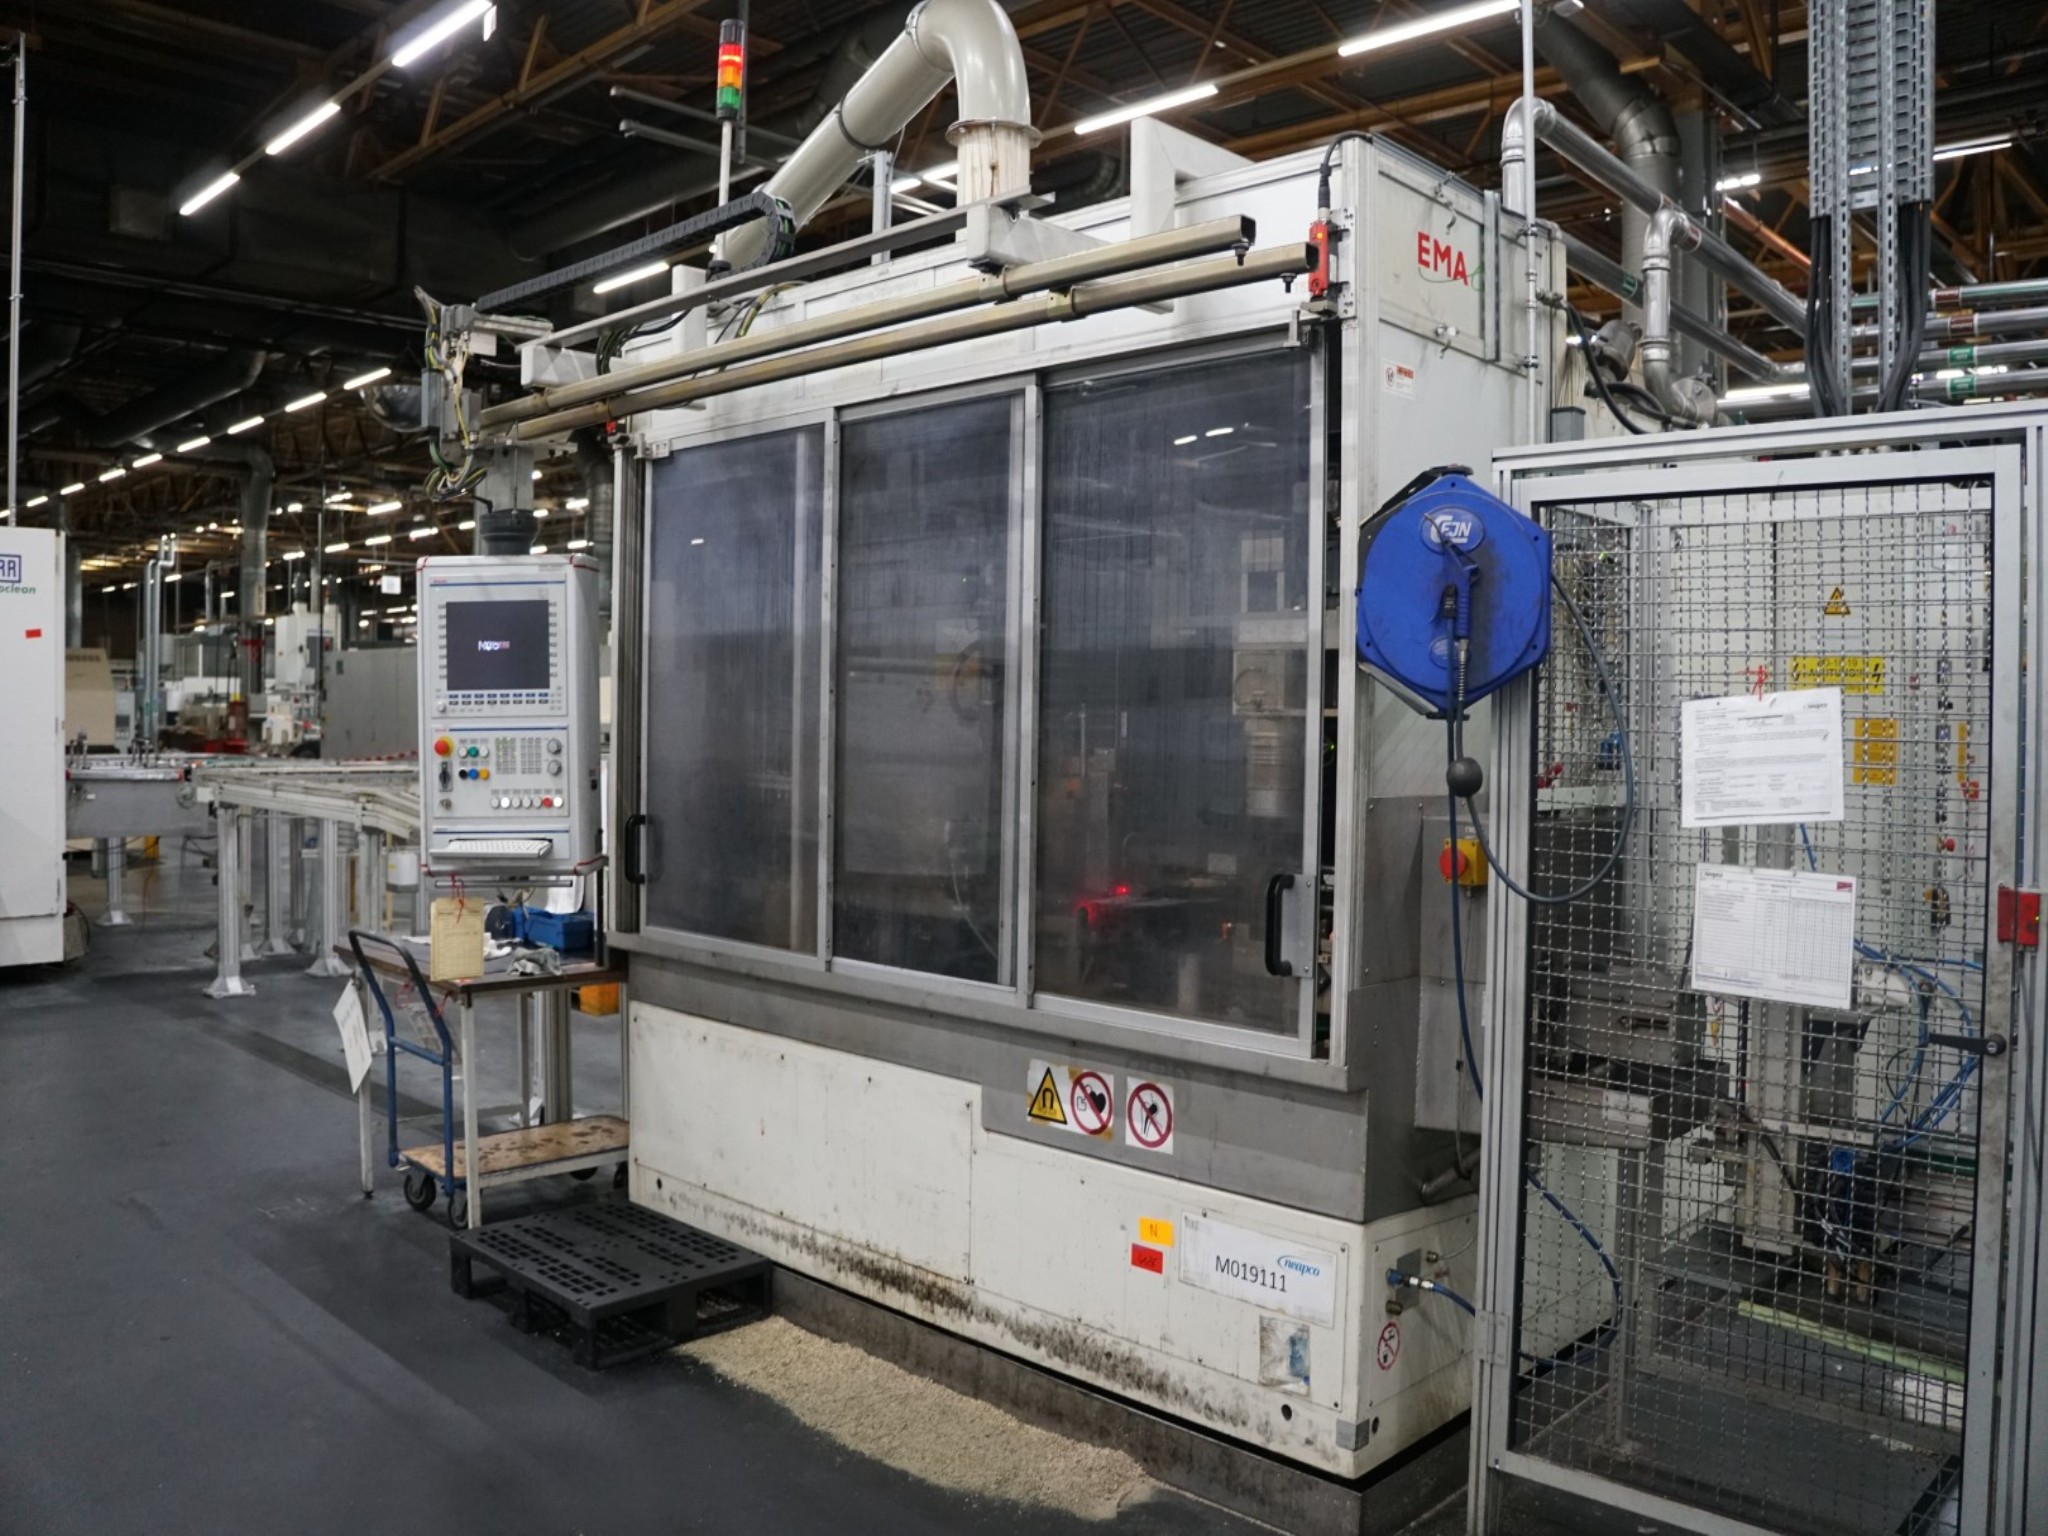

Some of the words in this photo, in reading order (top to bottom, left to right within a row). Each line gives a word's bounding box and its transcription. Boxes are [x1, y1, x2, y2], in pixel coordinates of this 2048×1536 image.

[1417, 231, 1468, 286] EMA
[1215, 1255, 1287, 1293] M019111
[1284, 1259, 1320, 1276] neapco
